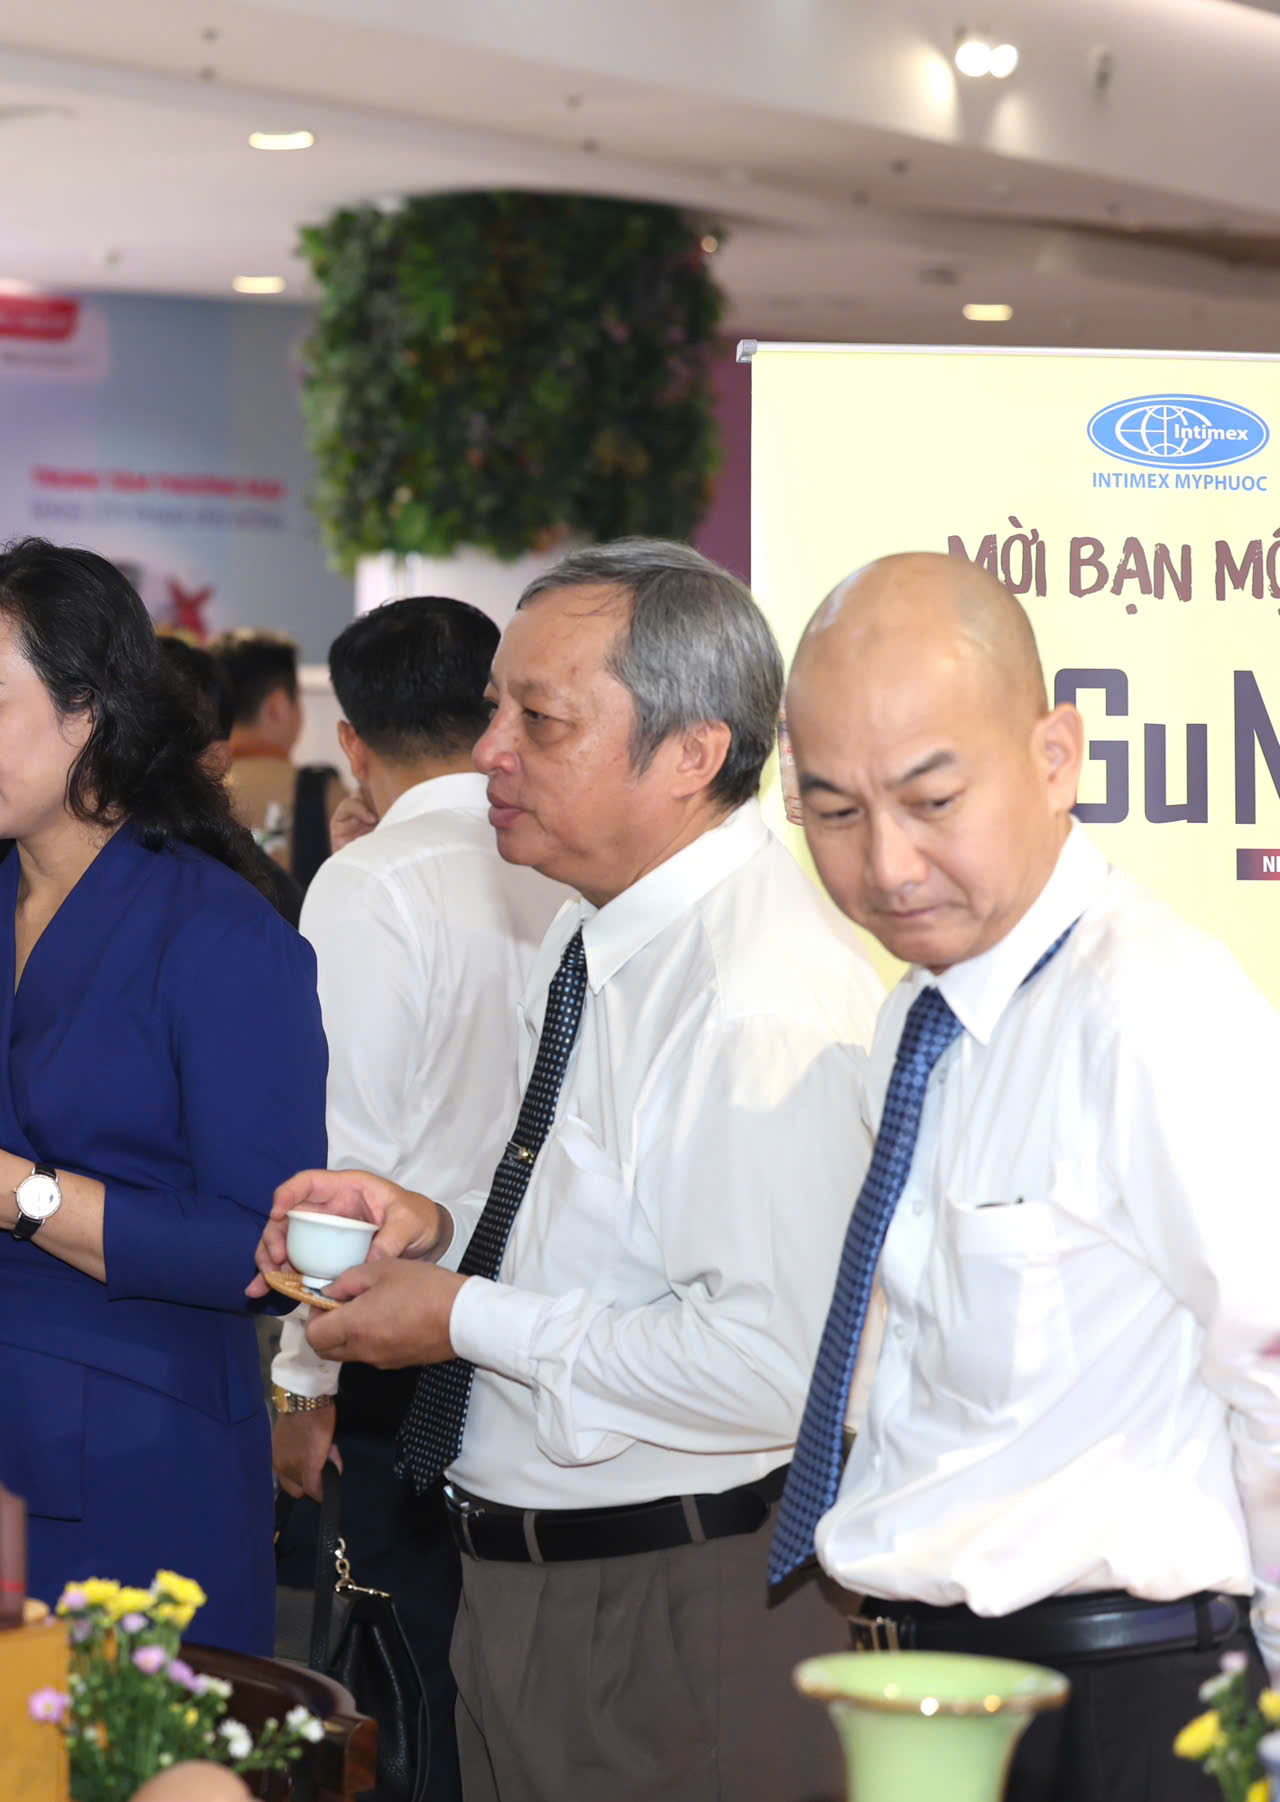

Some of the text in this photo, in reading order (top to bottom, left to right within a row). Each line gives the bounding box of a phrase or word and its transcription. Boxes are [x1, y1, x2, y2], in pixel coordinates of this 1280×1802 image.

[1174, 424, 1248, 440] Intimex
[1093, 472, 1267, 491] INTIMEX MYPHUOC
[1069, 536, 1192, 615] BẠN
